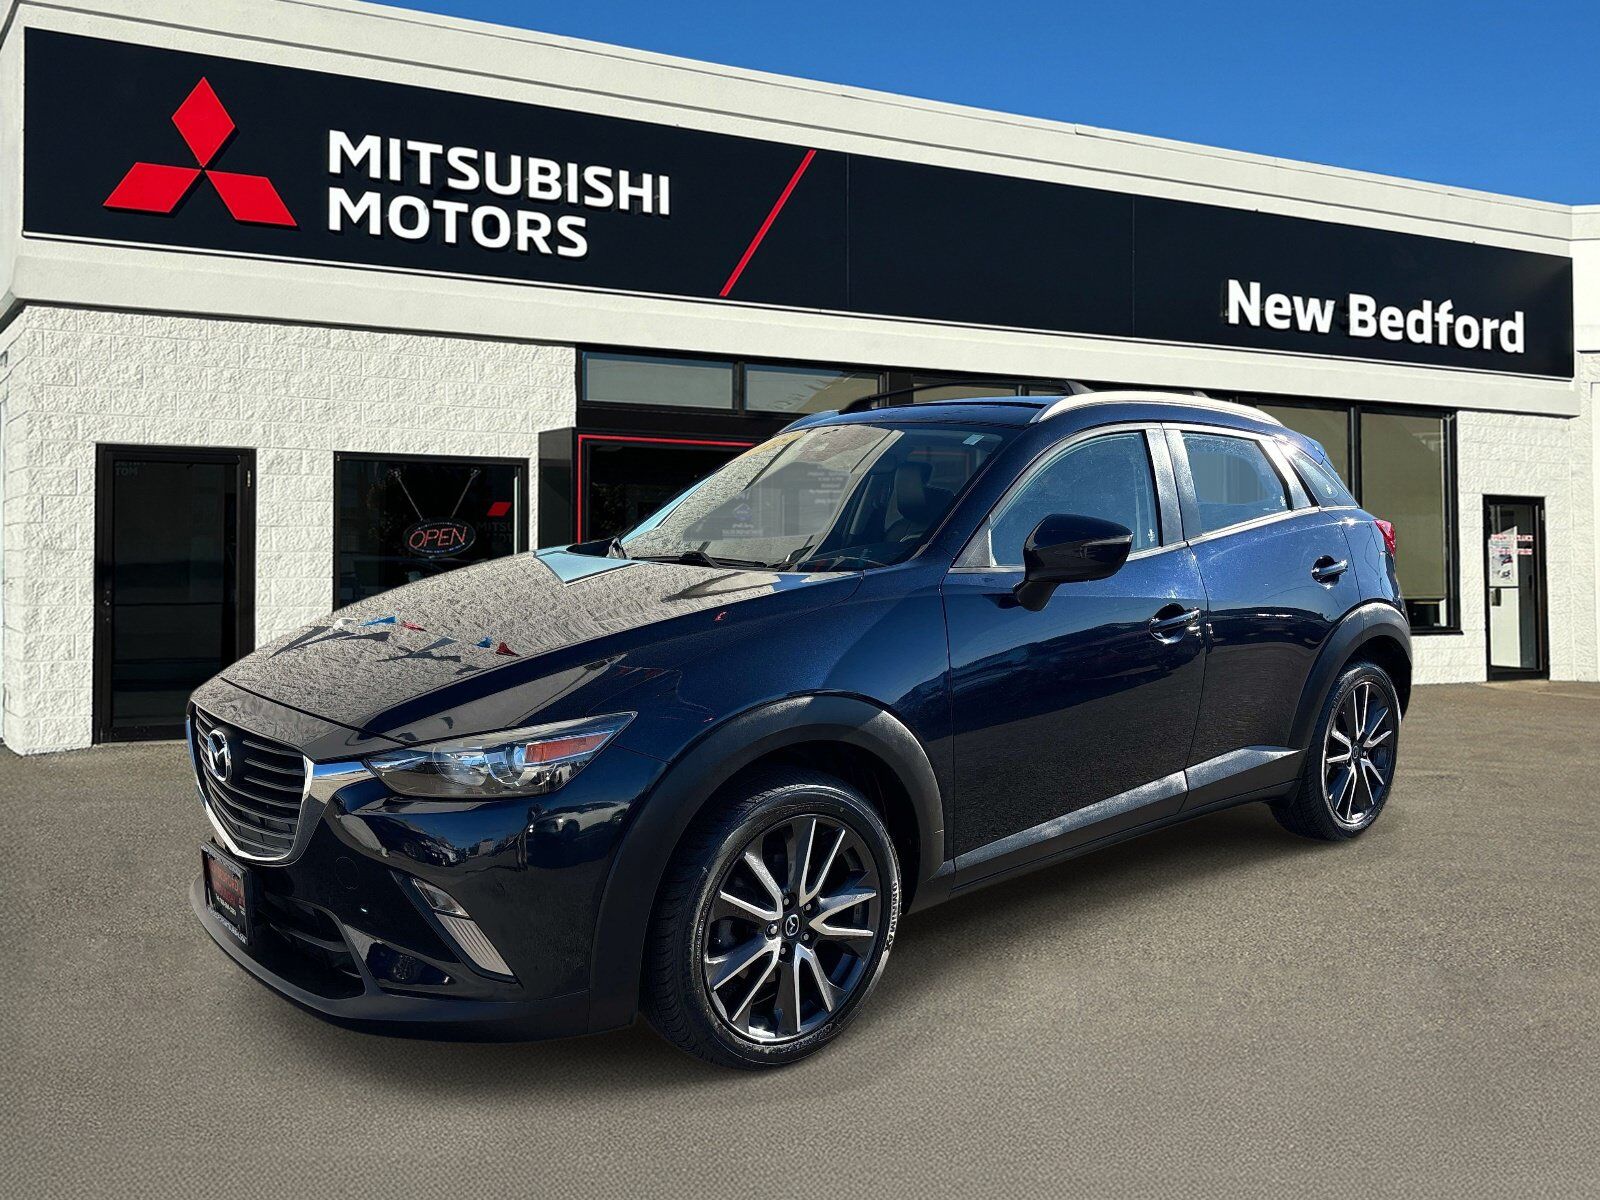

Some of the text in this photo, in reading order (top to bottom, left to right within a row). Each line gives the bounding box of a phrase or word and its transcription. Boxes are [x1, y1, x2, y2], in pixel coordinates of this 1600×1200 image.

[329, 129, 671, 216] MITSUBISHI
[329, 187, 588, 258] MOTORS
[1227, 279, 1524, 354] New Bedford
[409, 527, 467, 549] OPEN
